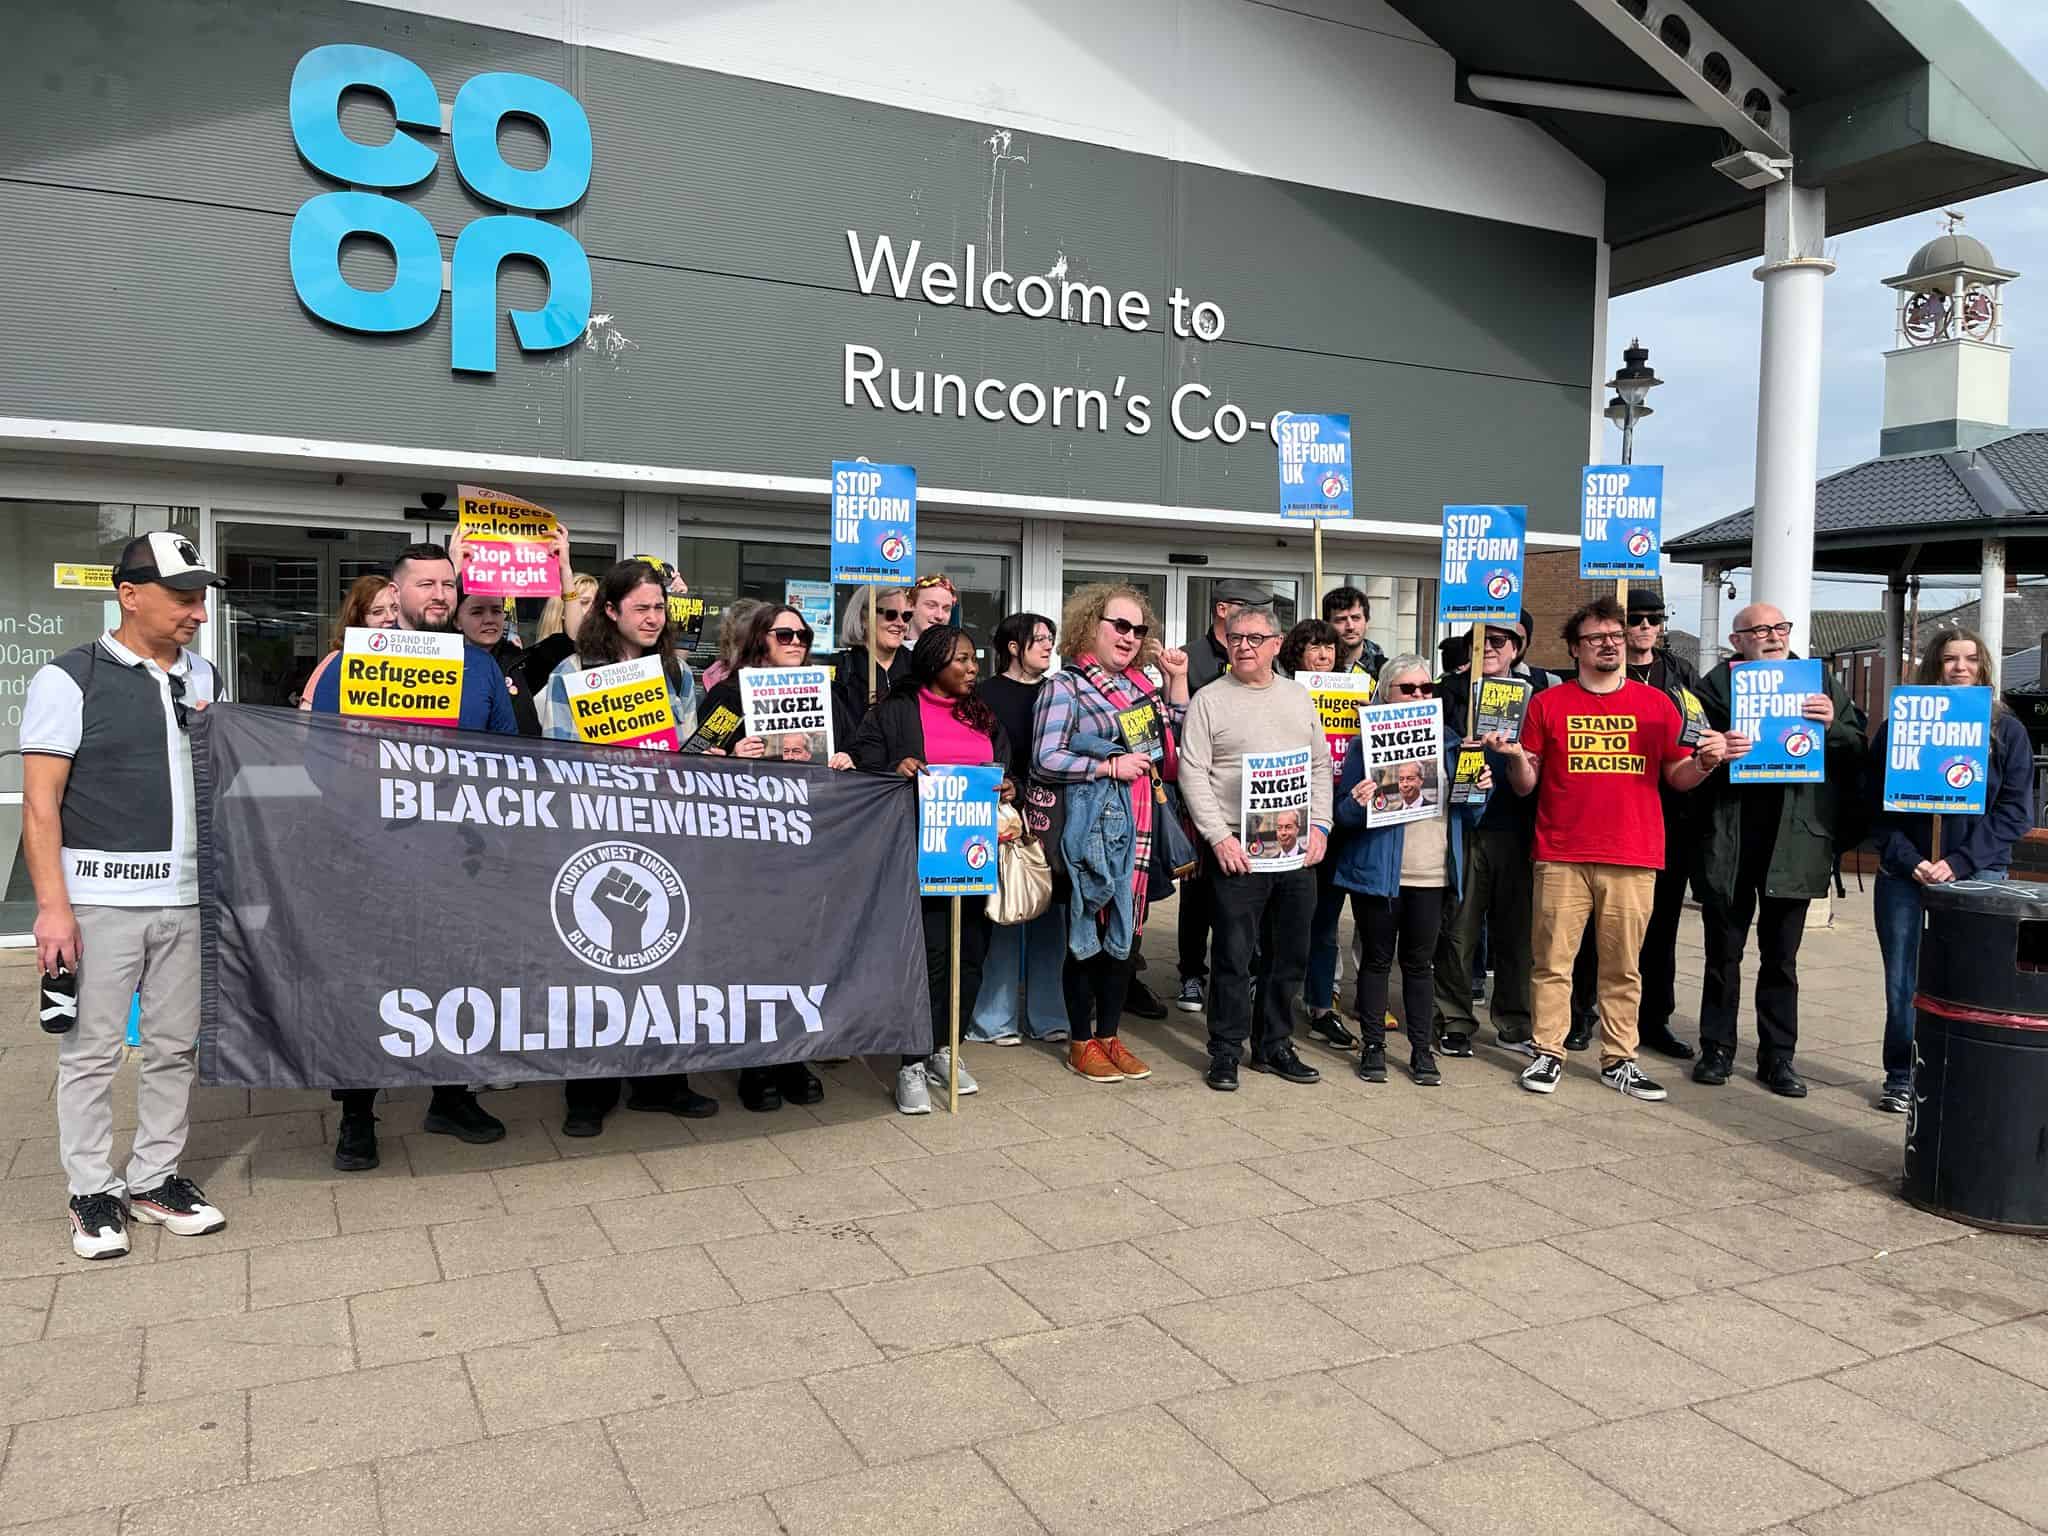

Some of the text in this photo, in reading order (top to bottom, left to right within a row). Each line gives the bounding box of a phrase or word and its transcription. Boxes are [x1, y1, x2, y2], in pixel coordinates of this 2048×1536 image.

[846, 230, 1225, 342] Welcome to
[844, 343, 1152, 436] Runcorn's
[1281, 422, 1320, 443] STOP
[1282, 443, 1345, 464] REFORM
[836, 471, 881, 497] STOP
[1283, 464, 1304, 485] UK
[1586, 474, 1630, 496] STOP
[465, 500, 552, 519] Refugees
[836, 495, 910, 522] REFORM
[1585, 497, 1656, 519] REFORM
[465, 519, 549, 536] welcome
[836, 520, 859, 544] UK
[1447, 515, 1491, 538] STOP
[1585, 519, 1608, 541] UK
[516, 546, 547, 563] the
[1446, 538, 1518, 561] REFORM
[467, 565, 548, 587] far right
[1444, 561, 1468, 584] UK
[390, 634, 436, 645] STAND UP
[390, 643, 440, 655] TO RACISM
[349, 659, 457, 688] Refugees
[602, 663, 640, 677] STAND UP
[605, 669, 645, 685] TO RACISM
[747, 672, 825, 687] WANTED
[753, 688, 776, 696] FOR
[1735, 669, 1784, 694] STOP
[348, 687, 450, 709] welcome
[576, 687, 665, 718] Refugees
[753, 696, 823, 715] NIGEL
[1893, 695, 1950, 720] STOP
[584, 709, 666, 739] welcome
[754, 715, 825, 732] FARAGE
[1321, 712, 1361, 728] lcome
[1365, 704, 1438, 723] WANTED
[1570, 717, 1634, 730] STAND
[1371, 722, 1391, 732] FOR
[1371, 727, 1436, 749] NIGEL
[1893, 720, 1983, 747] REFORM
[1570, 735, 1626, 750] UP TO
[1248, 751, 1309, 770] WANTED
[1371, 745, 1436, 764] FARAGE
[1570, 756, 1645, 772] RACISM
[1891, 746, 1921, 770] UK
[379, 738, 809, 805] NORTH WEST UNISON
[1252, 769, 1273, 778] FOR
[923, 775, 968, 801] STOP
[1250, 775, 1307, 795] NIGEL
[379, 777, 813, 846] BLACK MEMBERS
[1249, 791, 1308, 810] FARAGE
[924, 801, 992, 827] REFORM
[923, 826, 948, 853] UK
[76, 860, 171, 880] THE SPECIALS
[559, 846, 681, 897] NORTH WEST UNISON
[567, 928, 679, 968] BLACK MEMBERS
[378, 983, 828, 1058] SOLIDARITY
